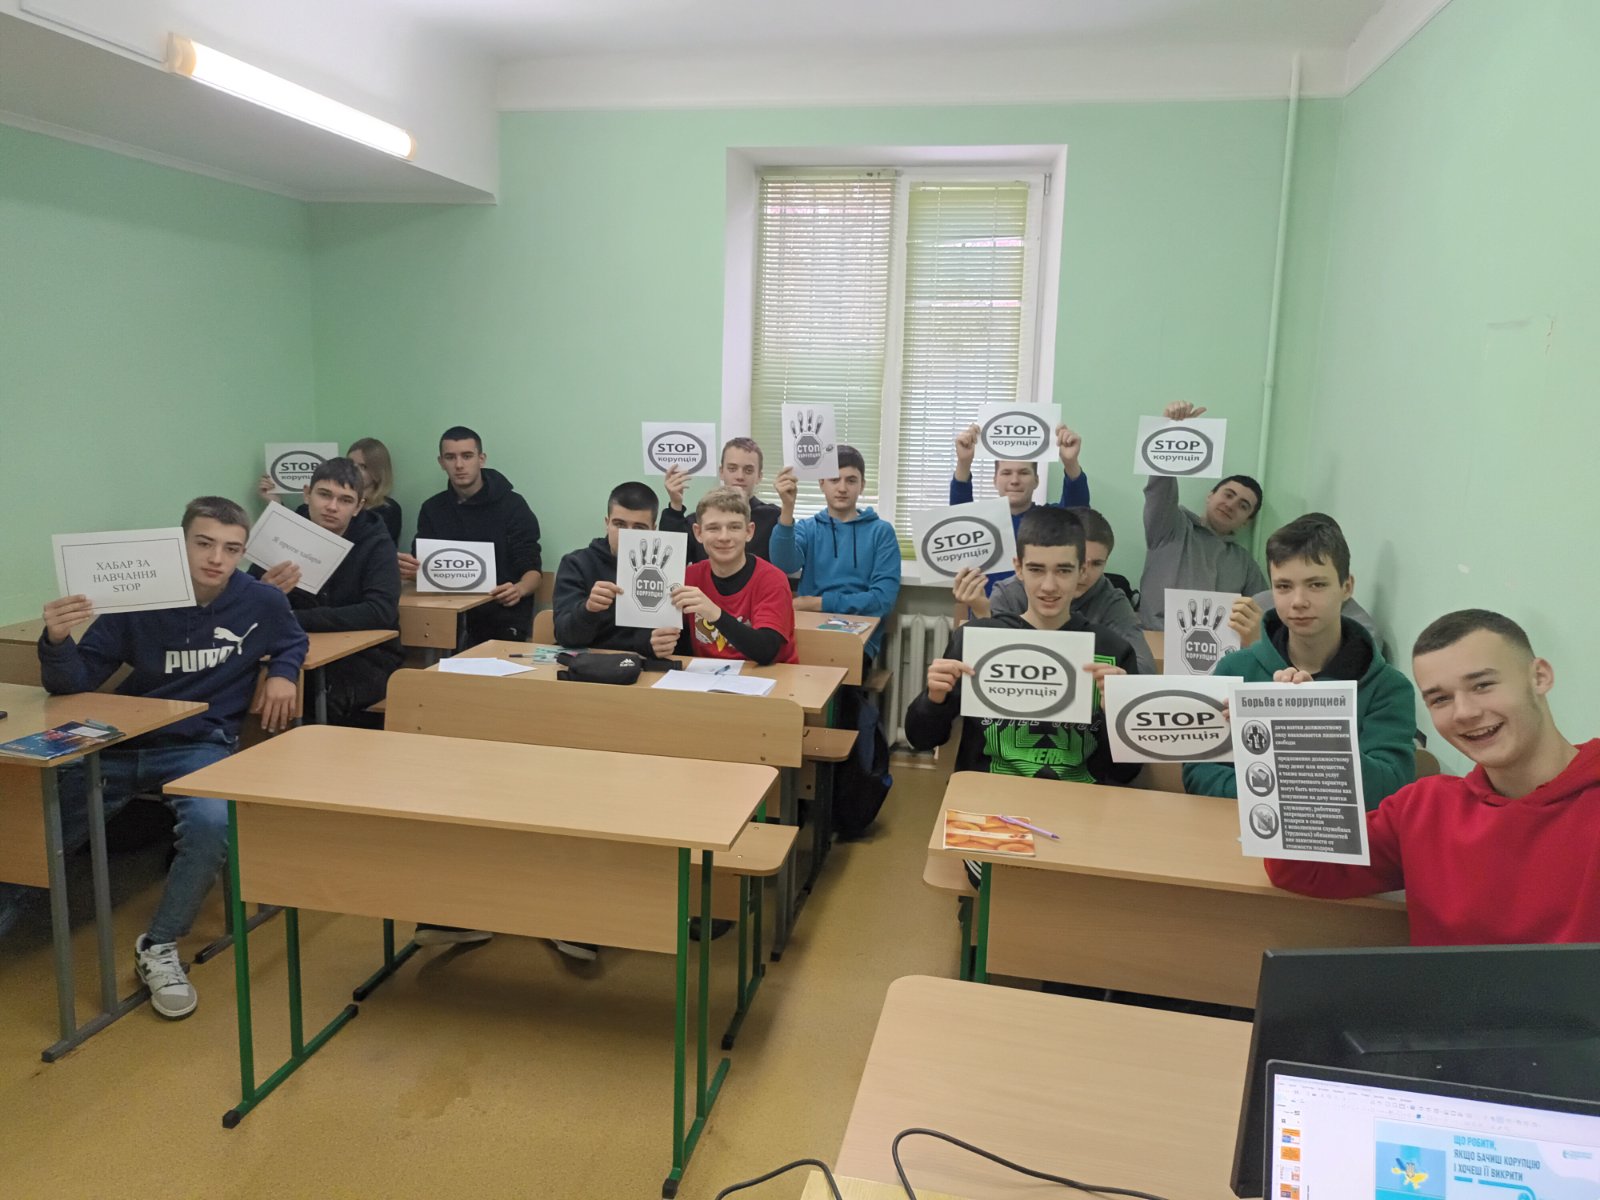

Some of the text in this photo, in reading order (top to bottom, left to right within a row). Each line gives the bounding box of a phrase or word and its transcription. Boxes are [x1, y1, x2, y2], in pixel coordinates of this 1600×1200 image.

[993, 425, 1038, 435] STOP
[657, 443, 696, 453] STOP
[797, 444, 820, 453] СТОП
[992, 439, 1038, 447] корупція
[1154, 440, 1200, 451] STOP
[1153, 454, 1200, 462] корупція
[281, 462, 319, 472] STOP
[933, 530, 985, 550] STOP
[936, 547, 989, 562] корупція
[96, 559, 151, 571] ХАБАР ЗА
[434, 559, 475, 569] STOP
[93, 570, 157, 583] НАВЧАННЯ
[112, 583, 141, 593] STOP
[636, 579, 664, 591] СТОП
[1186, 641, 1217, 654] СТОП
[164, 645, 235, 674] PUMA
[990, 663, 1057, 681] STOP
[988, 686, 1057, 697] корупція
[1241, 695, 1346, 708] Борьба с коррупцией
[1136, 712, 1215, 727] STOP
[1138, 732, 1220, 743] корупція
[1454, 1149, 1541, 1170] ЯКЩО БАЧИШ КОРУПЦІЮ
[1458, 1163, 1482, 1176] ХОЧЕШ
